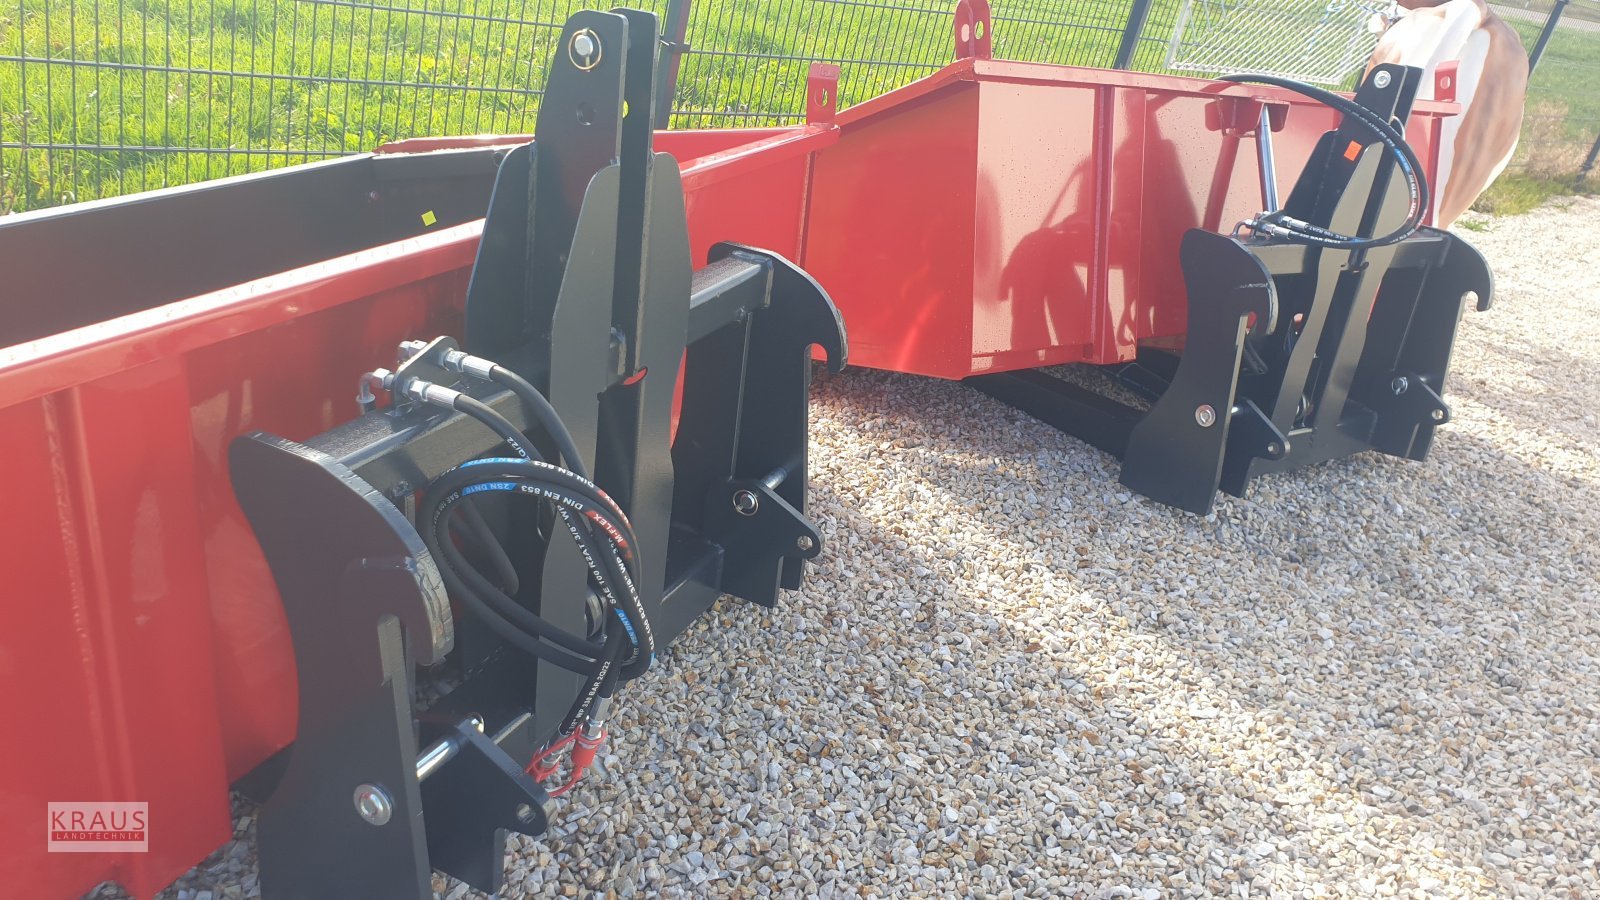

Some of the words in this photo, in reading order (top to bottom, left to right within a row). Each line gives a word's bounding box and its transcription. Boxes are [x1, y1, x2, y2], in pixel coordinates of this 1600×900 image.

[558, 466, 574, 477] EN
[577, 475, 594, 488] DIN
[521, 485, 541, 495] 853
[544, 490, 560, 501] EN
[562, 497, 583, 510] DIN
[557, 505, 571, 520] WP
[593, 513, 624, 543] M-FLEX
[577, 543, 594, 568] R2AT
[616, 556, 627, 571] WP
[594, 569, 605, 585] 100
[603, 587, 616, 605] SAE
[633, 595, 646, 619] R2AT
[588, 680, 601, 697] BAR
[599, 661, 611, 681] 2Q/22
